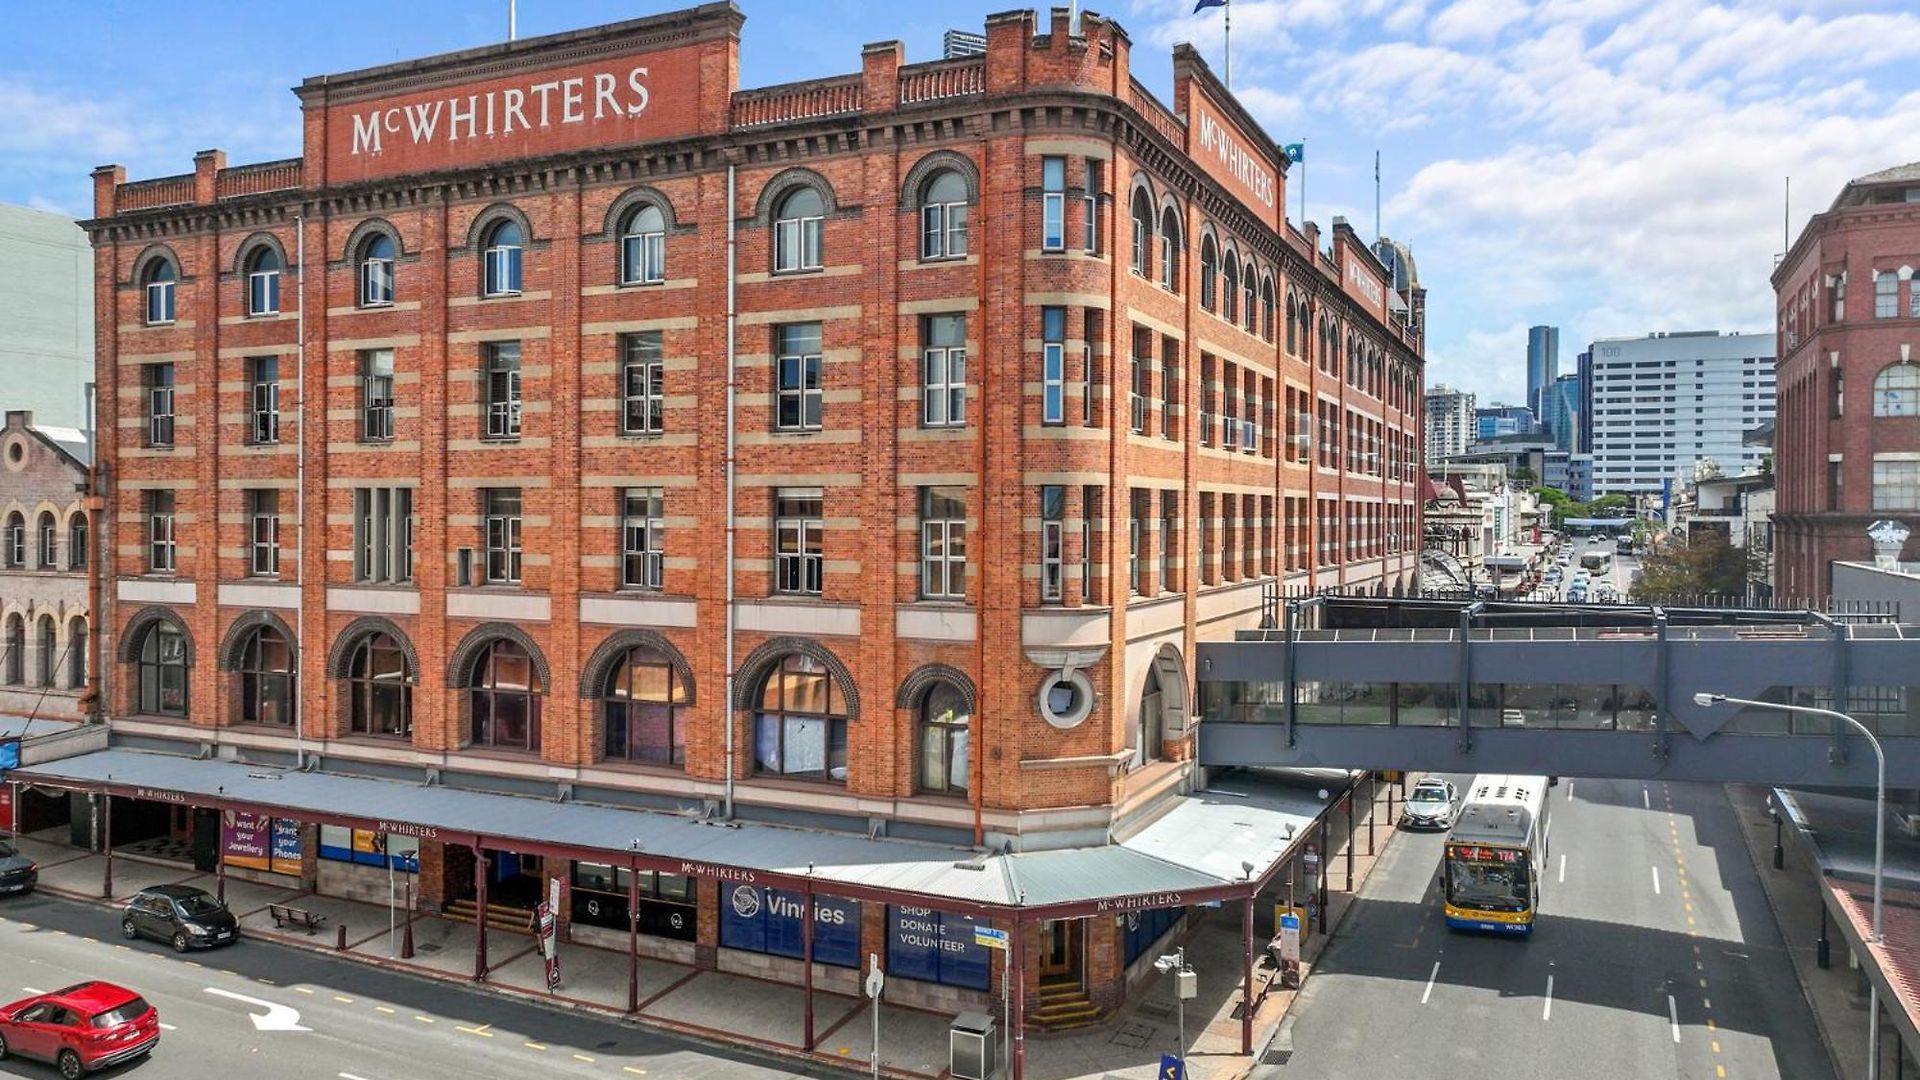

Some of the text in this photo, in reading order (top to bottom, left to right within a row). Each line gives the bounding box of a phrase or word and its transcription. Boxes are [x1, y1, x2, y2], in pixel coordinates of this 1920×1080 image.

[236, 821, 255, 829] want
[236, 832, 254, 841] your
[228, 842, 263, 856] Jewellery
[278, 839, 297, 847] your
[273, 848, 302, 860] Phones
[766, 895, 846, 925] Vinies
[900, 905, 932, 917] SHOP
[900, 919, 946, 935] DONATE
[900, 934, 966, 953] VOLUNTEER
